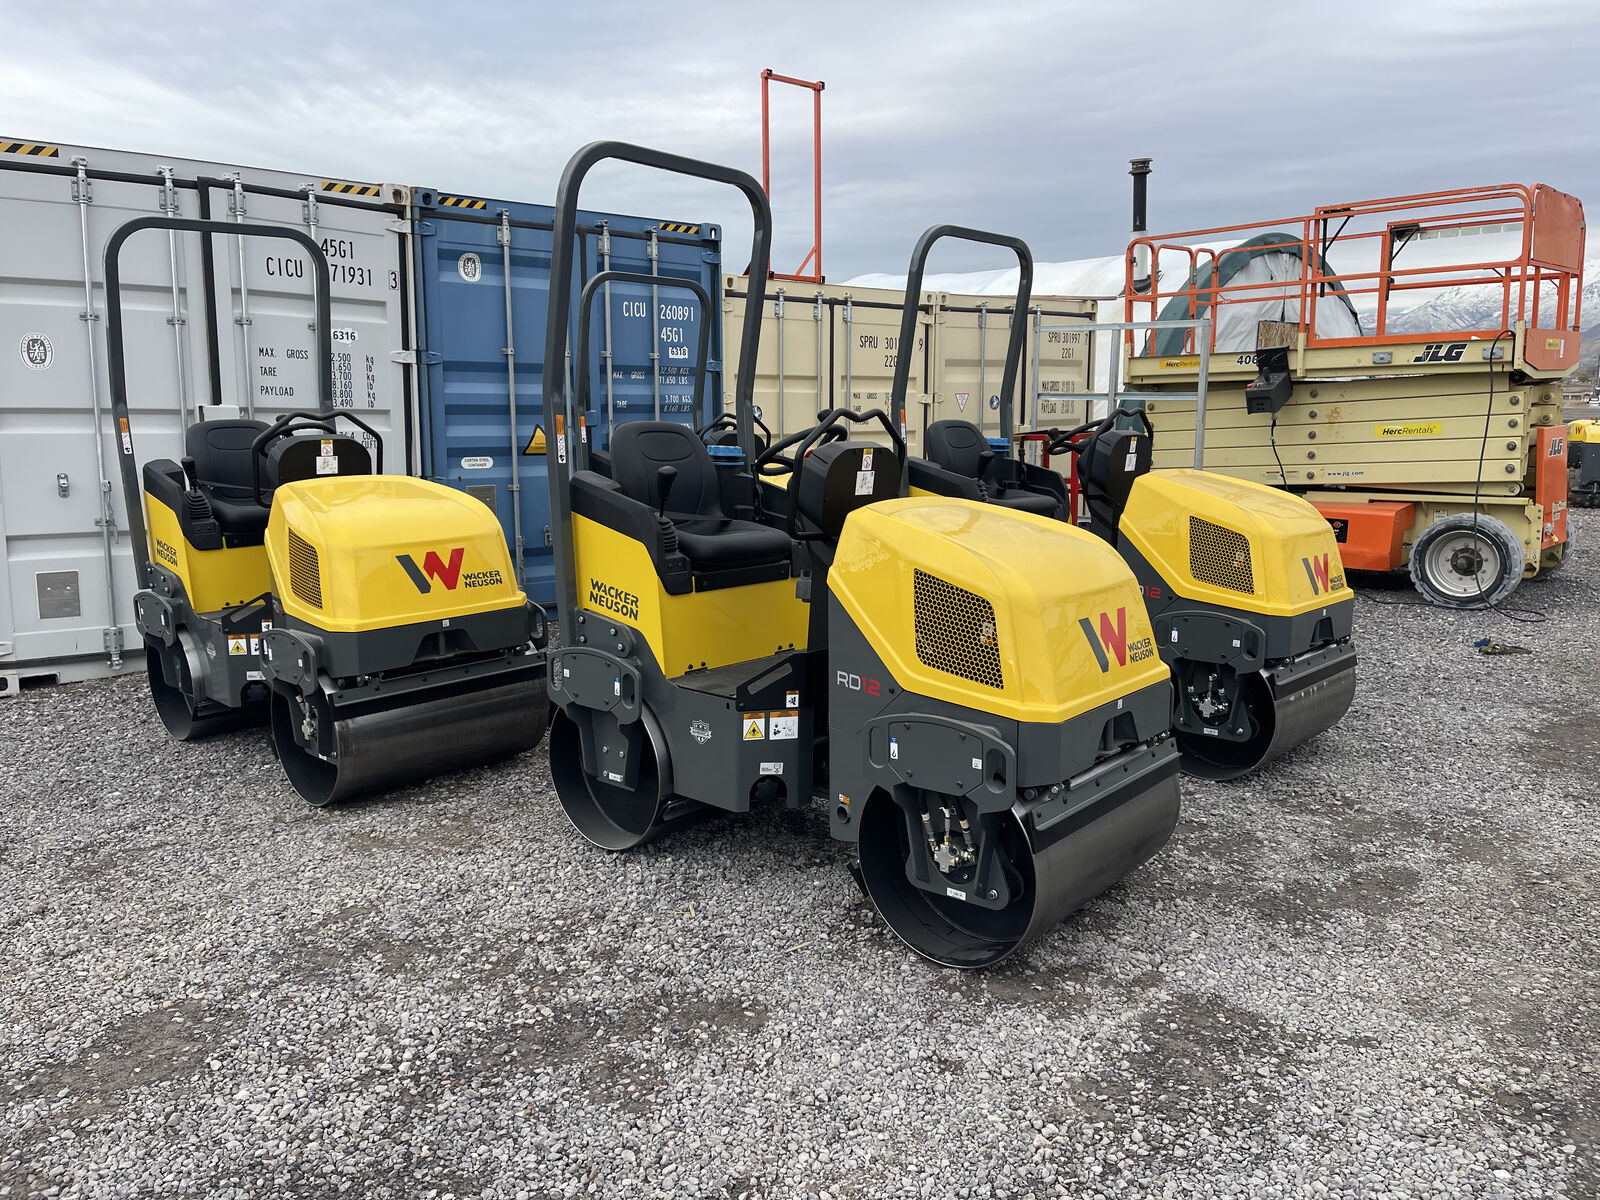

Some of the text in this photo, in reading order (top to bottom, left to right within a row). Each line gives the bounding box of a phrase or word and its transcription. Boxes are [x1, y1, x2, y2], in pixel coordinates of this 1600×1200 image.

[320, 238, 354, 259] 45G1
[266, 257, 398, 289] CICU 71931 3
[623, 302, 694, 322] CICU 260891
[333, 330, 356, 340] 6316
[661, 327, 683, 343] 45G1
[860, 335, 878, 349] SPRU
[1048, 331, 1061, 343] SPRU
[1062, 332, 1081, 344] 301997
[286, 348, 309, 360] GROSS
[330, 353, 351, 363] 2.500
[365, 355, 374, 366] kg
[670, 347, 687, 356] 6318
[1062, 347, 1074, 358] 22G1
[1412, 343, 1468, 363] JLG
[260, 366, 277, 377] TARE
[366, 373, 375, 384] kg
[332, 363, 352, 373] 1.650
[260, 385, 376, 401] PAYLOAD 8.800 kg
[333, 398, 354, 408] 3.490
[1382, 426, 1434, 436] HercRentals
[1548, 437, 1563, 456] JLG
[462, 570, 501, 581] WACKER
[464, 578, 503, 589] NEUSON
[590, 577, 639, 609] WACKER
[589, 590, 639, 622] NEUSON
[1127, 637, 1152, 653] WACKER
[1129, 648, 1155, 664] NEUSON
[836, 670, 881, 697] RD12
